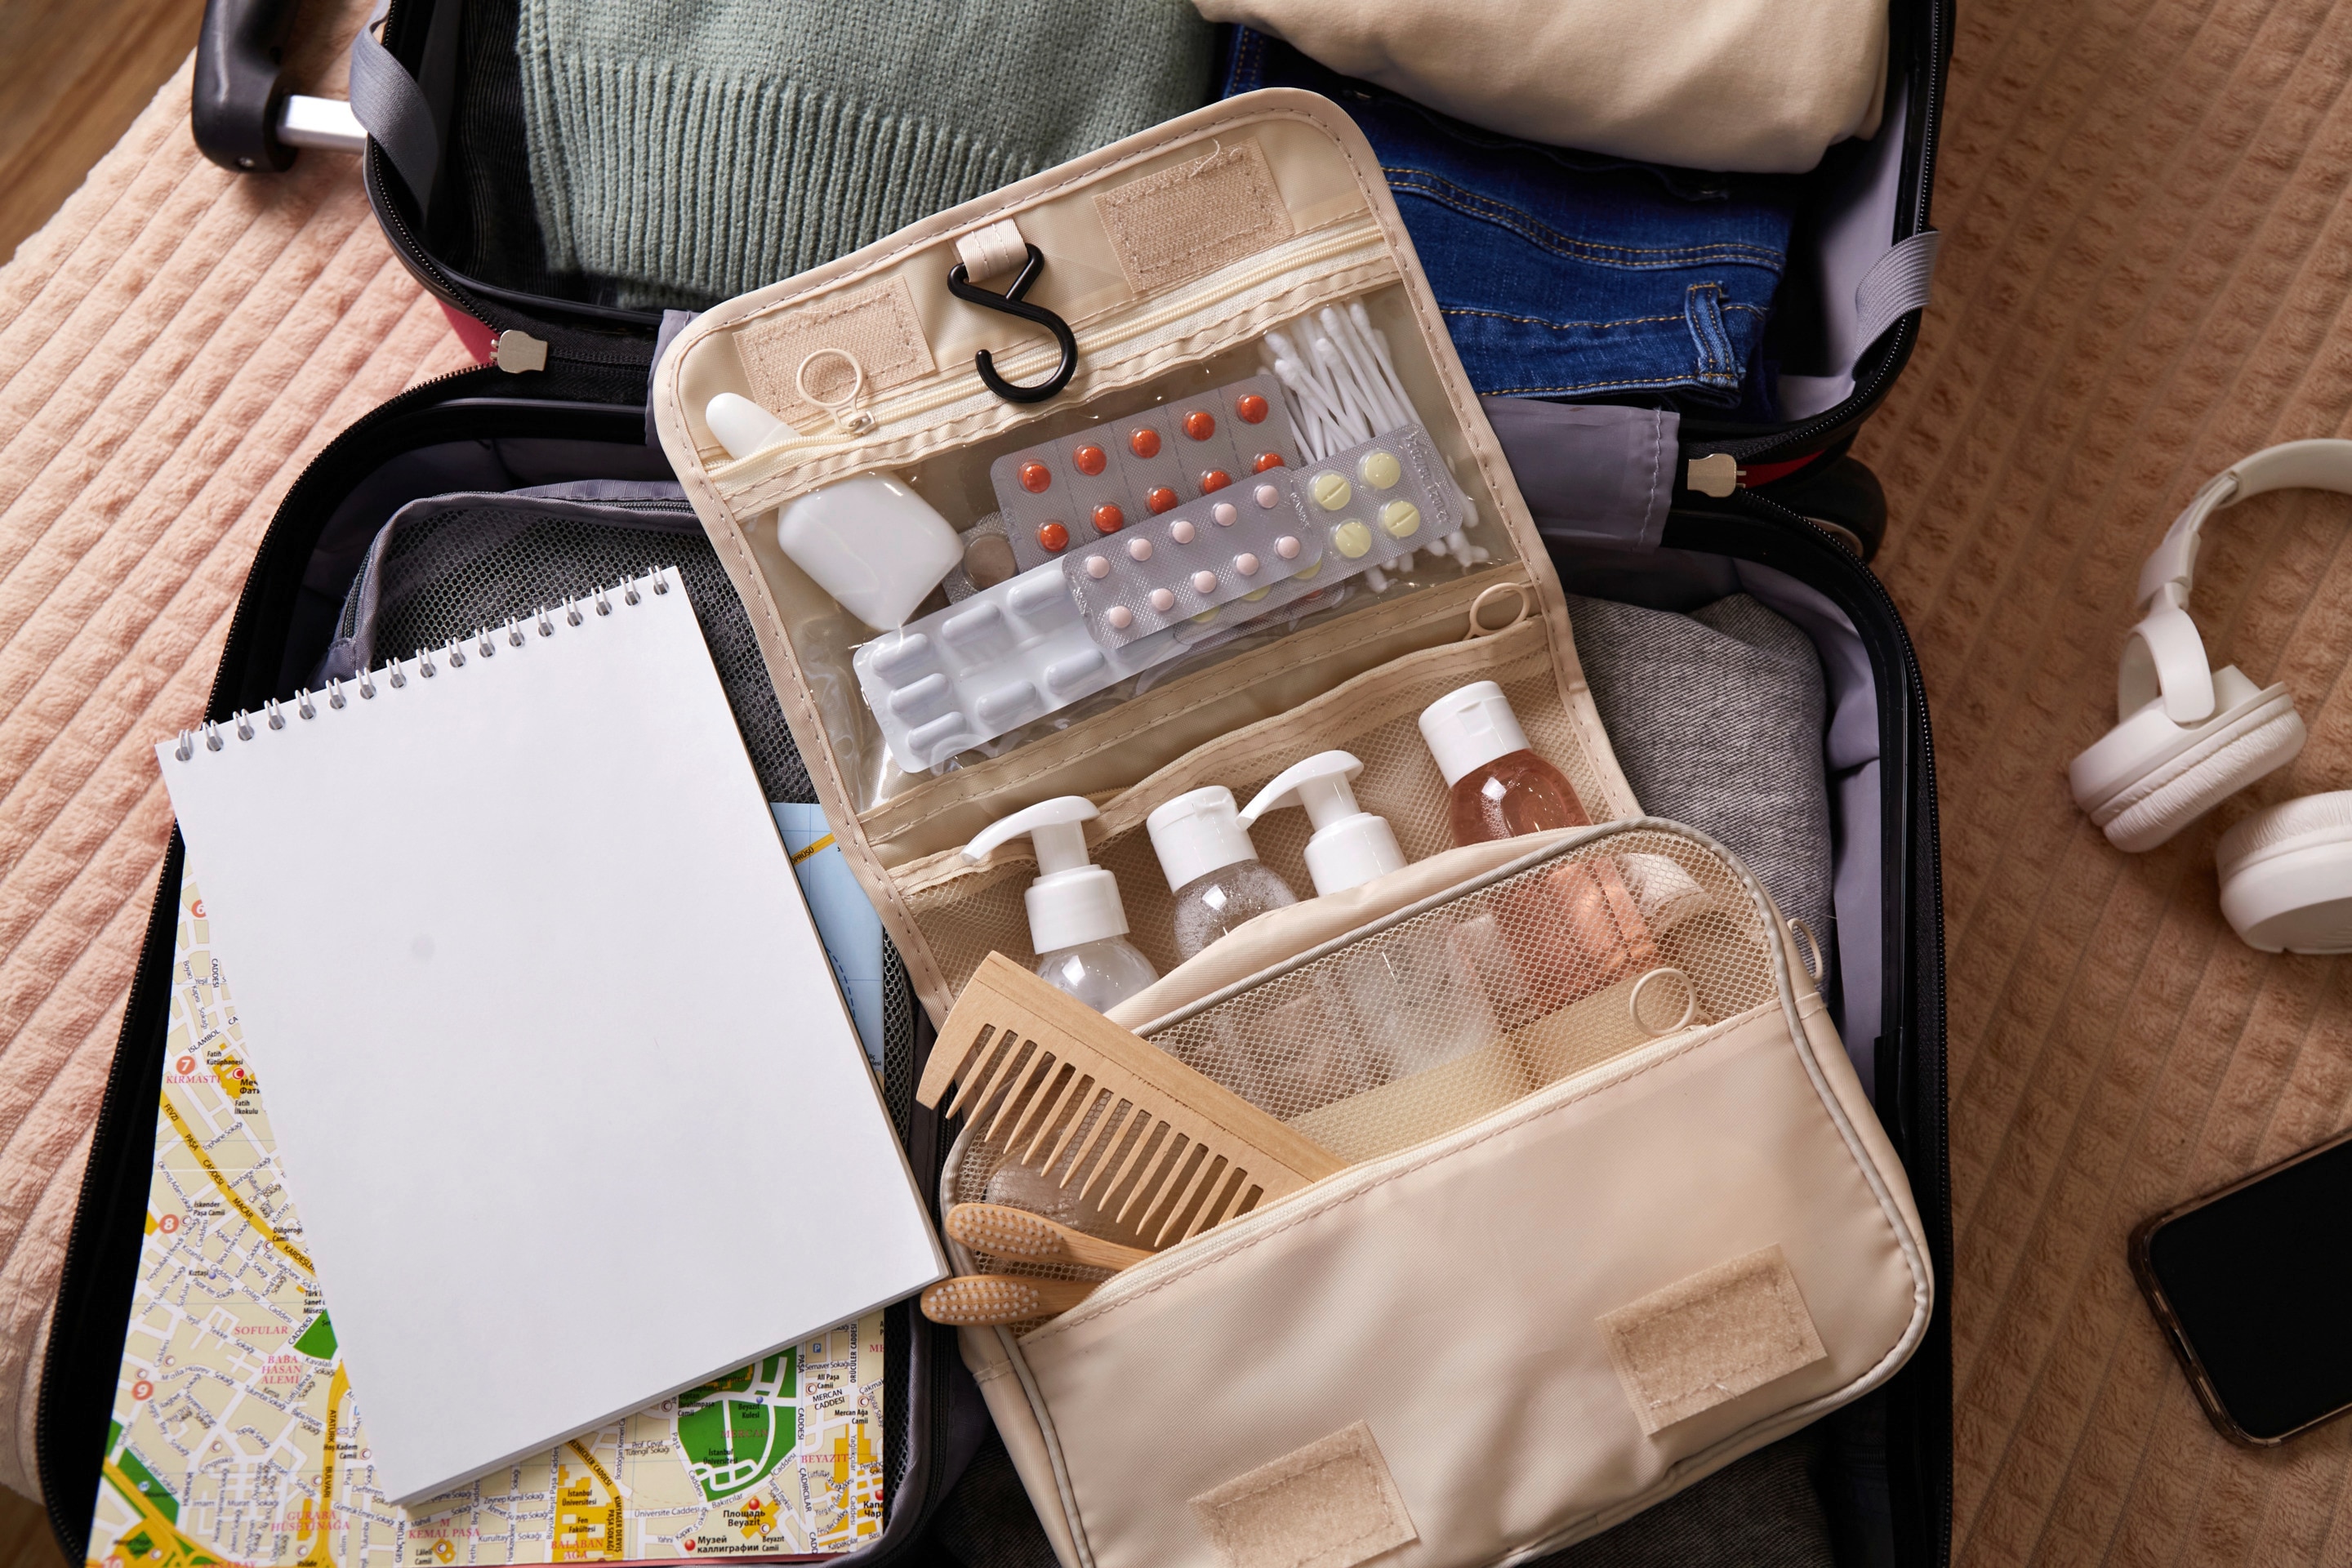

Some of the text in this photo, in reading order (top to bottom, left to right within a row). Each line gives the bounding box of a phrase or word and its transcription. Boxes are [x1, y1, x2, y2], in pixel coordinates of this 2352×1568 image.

[184, 1134, 199, 1152] PAŞA
[232, 1197, 253, 1219] MACAR
[268, 1304, 292, 1325] Caddesi
[234, 1325, 289, 1336] SOFULAR
[268, 1355, 298, 1365] BABA
[797, 1354, 805, 1374] PAŞA
[261, 1365, 302, 1374] HASAN
[805, 1361, 851, 1372] Semaver Sokağı
[826, 1374, 840, 1382] Paşa
[813, 1388, 843, 1403] MERCAN
[814, 1396, 845, 1410] CADDESI
[742, 1411, 760, 1419] Kulesi
[857, 1409, 868, 1417] Ağa
[721, 1428, 769, 1438] MERCAN
[651, 1446, 670, 1454] Sokağı
[708, 1448, 734, 1456] İstanbul
[672, 1432, 704, 1498] Paşa Caddesi
[703, 1456, 738, 1465] Üniversitesi
[772, 1453, 796, 1477] Caddesi
[524, 1493, 545, 1502] Sokağı
[567, 1489, 593, 1497] İstanbul
[562, 1498, 597, 1507] Üniversitesi
[470, 1511, 480, 1526] Bey
[607, 1509, 615, 1525] PAŞA
[723, 1510, 766, 1519] Площадь
[408, 1530, 450, 1539] KEMAL
[517, 1533, 542, 1543] Sokağı
[550, 1539, 604, 1549] BALABAN
[697, 1535, 728, 1546] Музей
[697, 1544, 760, 1554] каллиграфии
